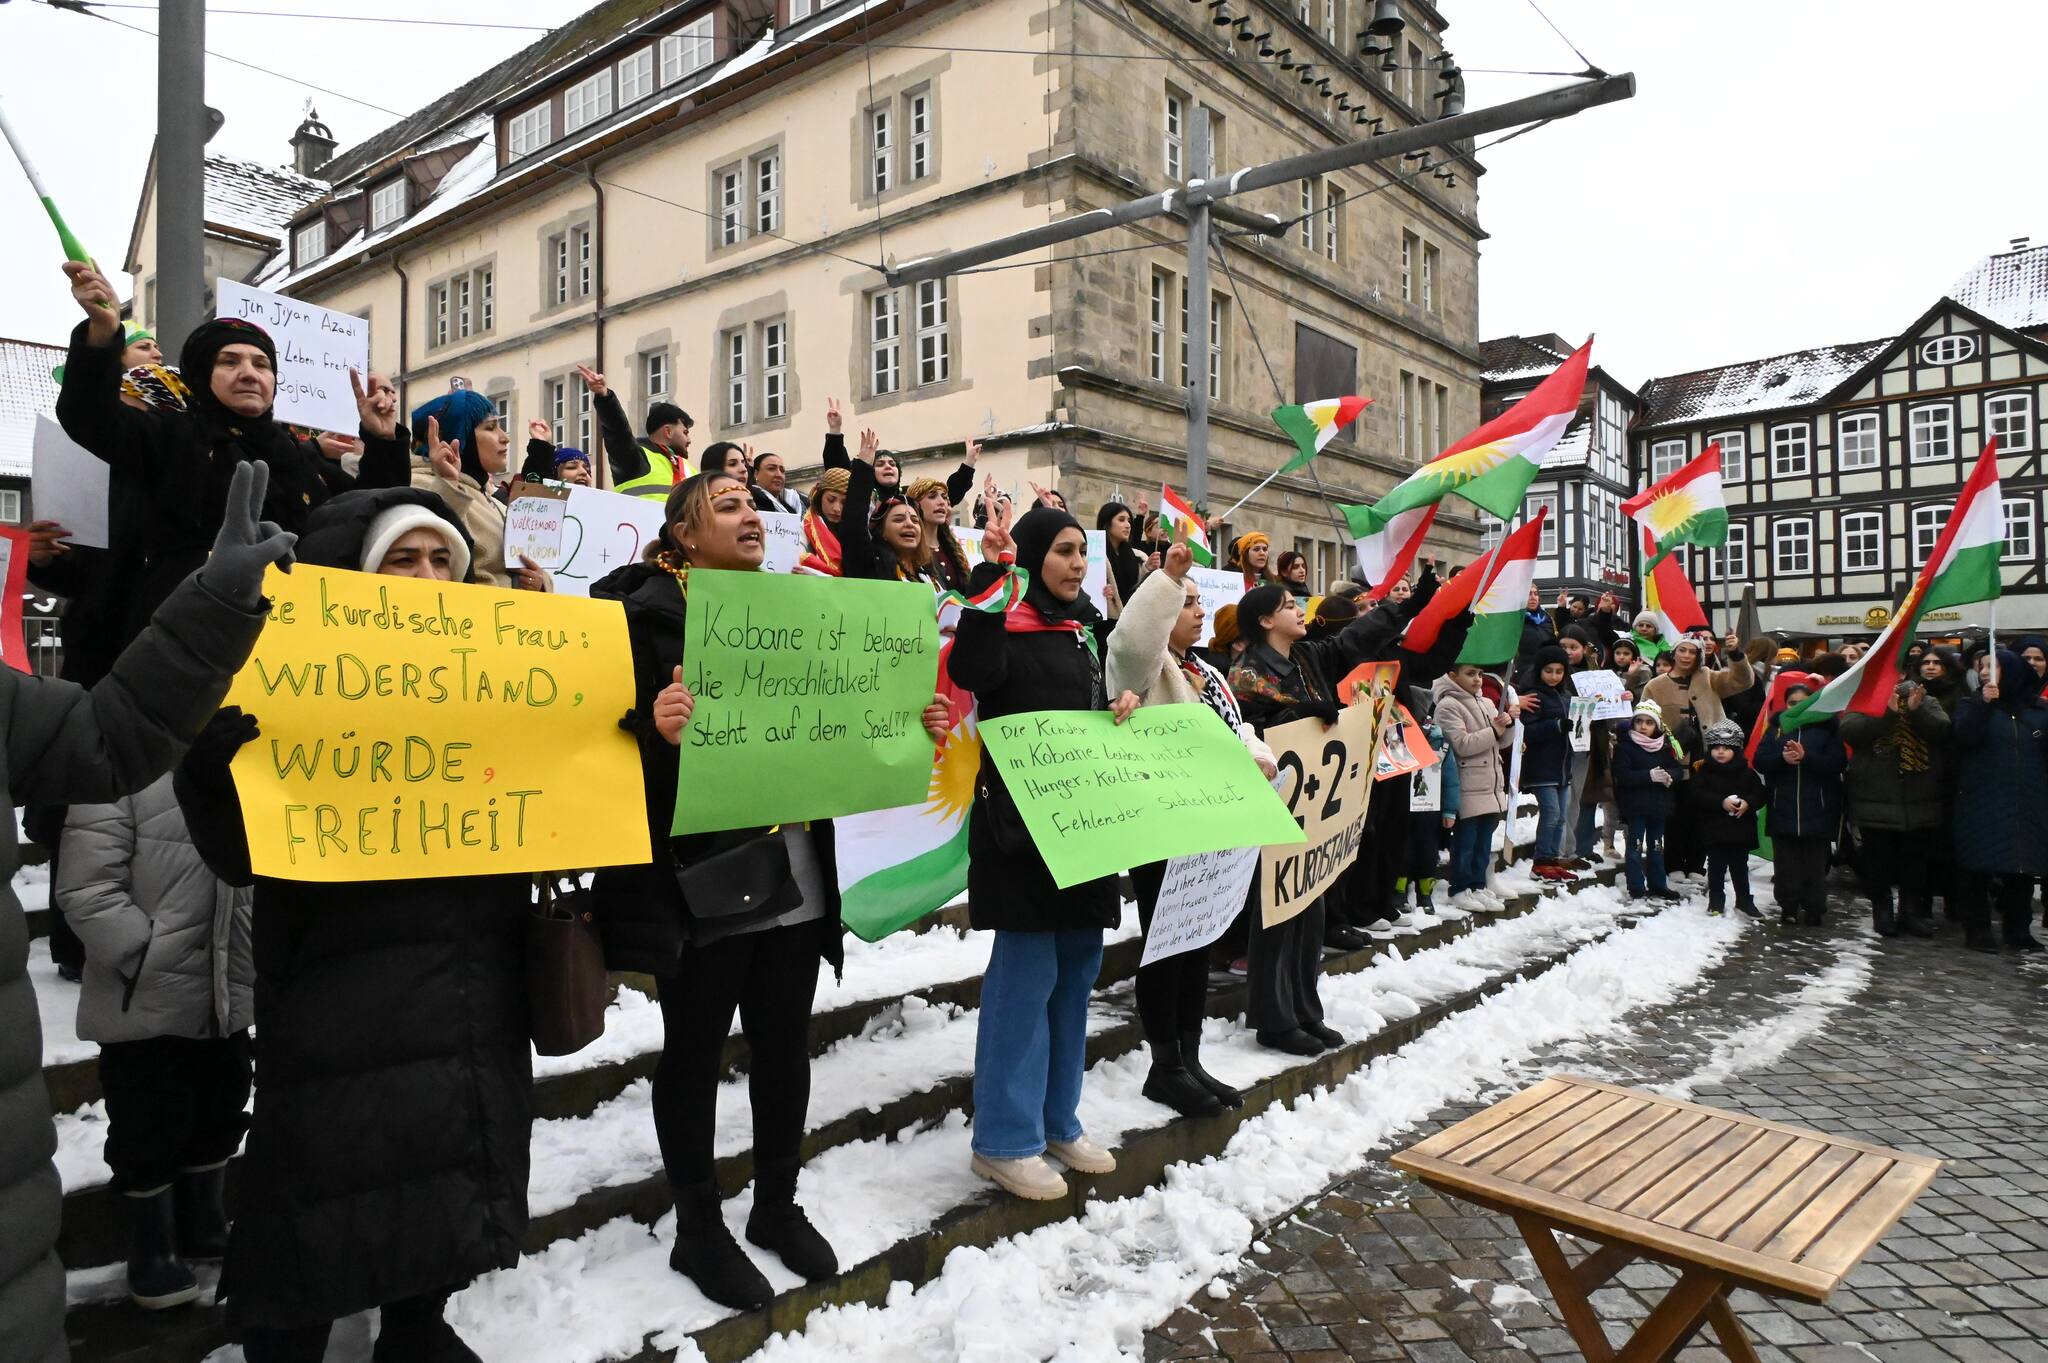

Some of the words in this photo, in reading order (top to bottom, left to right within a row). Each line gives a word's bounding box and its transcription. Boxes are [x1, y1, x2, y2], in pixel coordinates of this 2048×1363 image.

[239, 298, 264, 319] Jin
[270, 302, 311, 328] Jiyan
[276, 370, 327, 403] Rojava
[554, 515, 589, 578] 2
[600, 548, 611, 564] +
[268, 595, 297, 624] ie
[320, 577, 474, 639] kurdische
[704, 600, 804, 651] Kobane
[817, 613, 847, 651] ist
[863, 616, 925, 668] belagert
[687, 660, 724, 700] die
[734, 656, 881, 698] Menschlichkeit
[765, 705, 801, 742] auf
[809, 709, 847, 742] dem
[1035, 717, 1088, 737] Kinder
[1127, 715, 1202, 740] Frauen
[1029, 742, 1100, 767] Kobane
[1152, 744, 1204, 762] unter
[1052, 801, 1144, 838] Fehlender
[1158, 781, 1244, 810] Sicherheit
